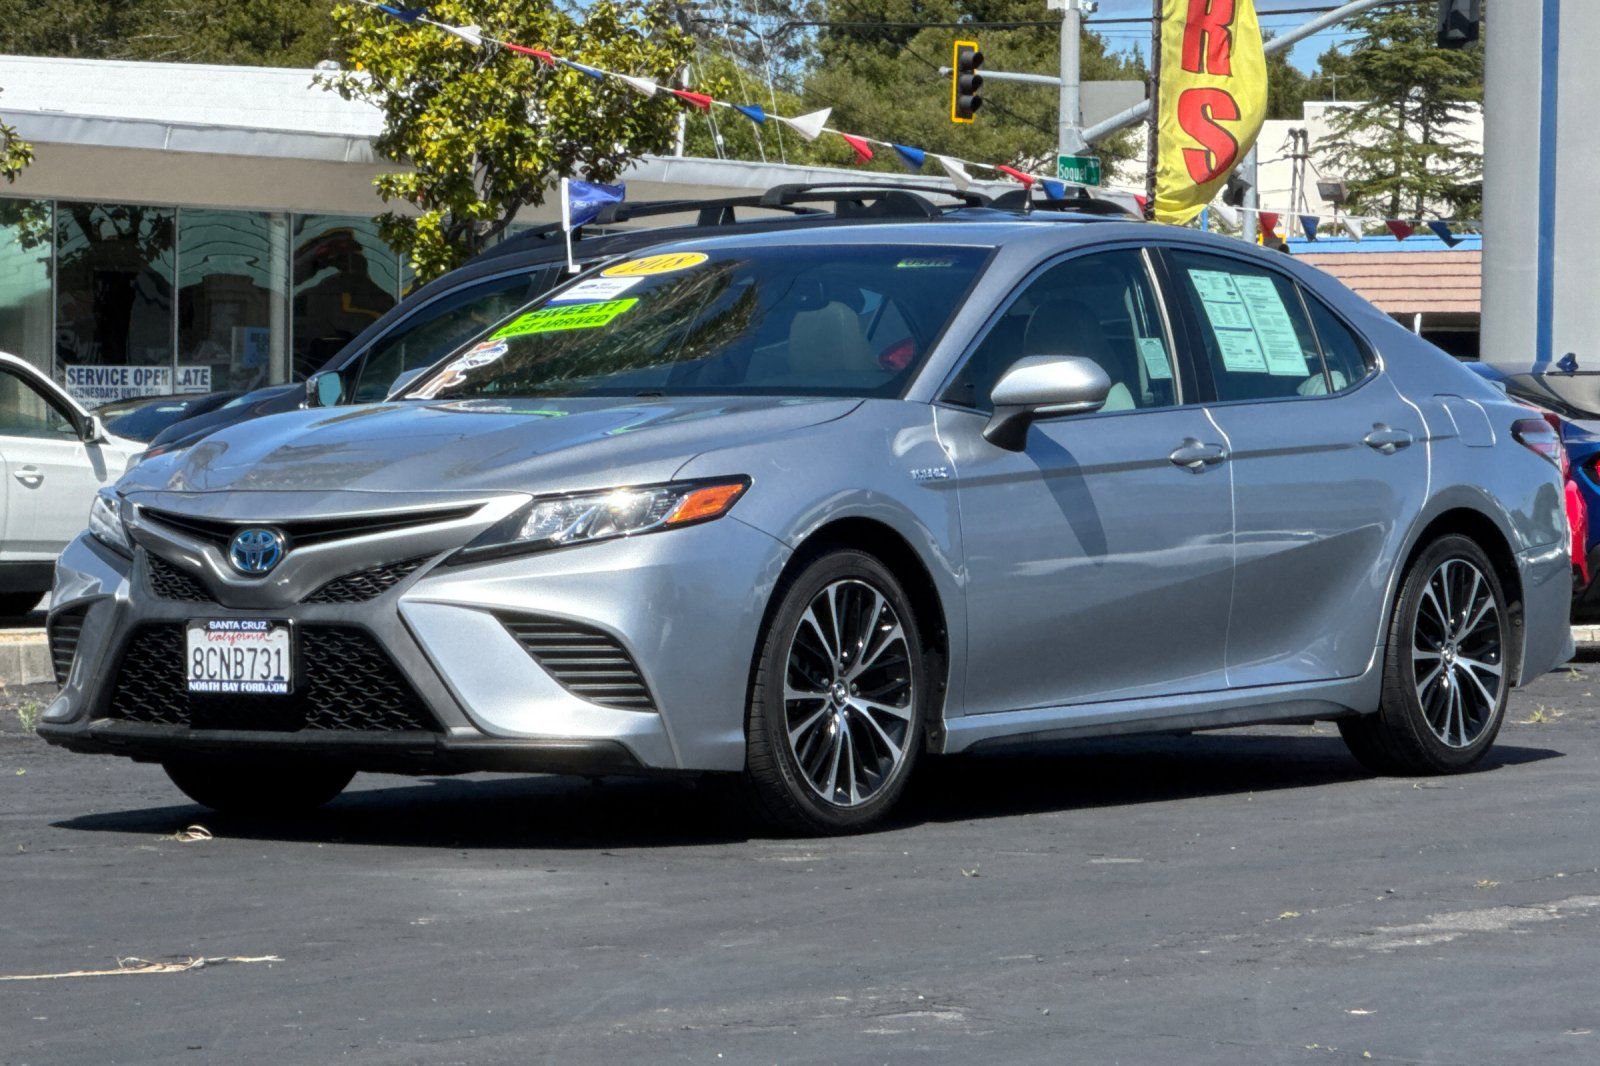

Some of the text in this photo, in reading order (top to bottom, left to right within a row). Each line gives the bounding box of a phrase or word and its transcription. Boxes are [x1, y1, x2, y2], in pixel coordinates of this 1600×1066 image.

[1059, 163, 1087, 182] Soquel
[523, 300, 624, 323] SWEET!
[537, 313, 610, 330] ARRIVED
[67, 368, 129, 386] SERVICE
[133, 368, 169, 386] OPEN
[209, 621, 267, 630] SANTA CRUZ
[207, 631, 273, 646] California
[192, 647, 285, 681] 8CNB731
[188, 682, 220, 692] NORTH
[221, 682, 239, 692] BAY
